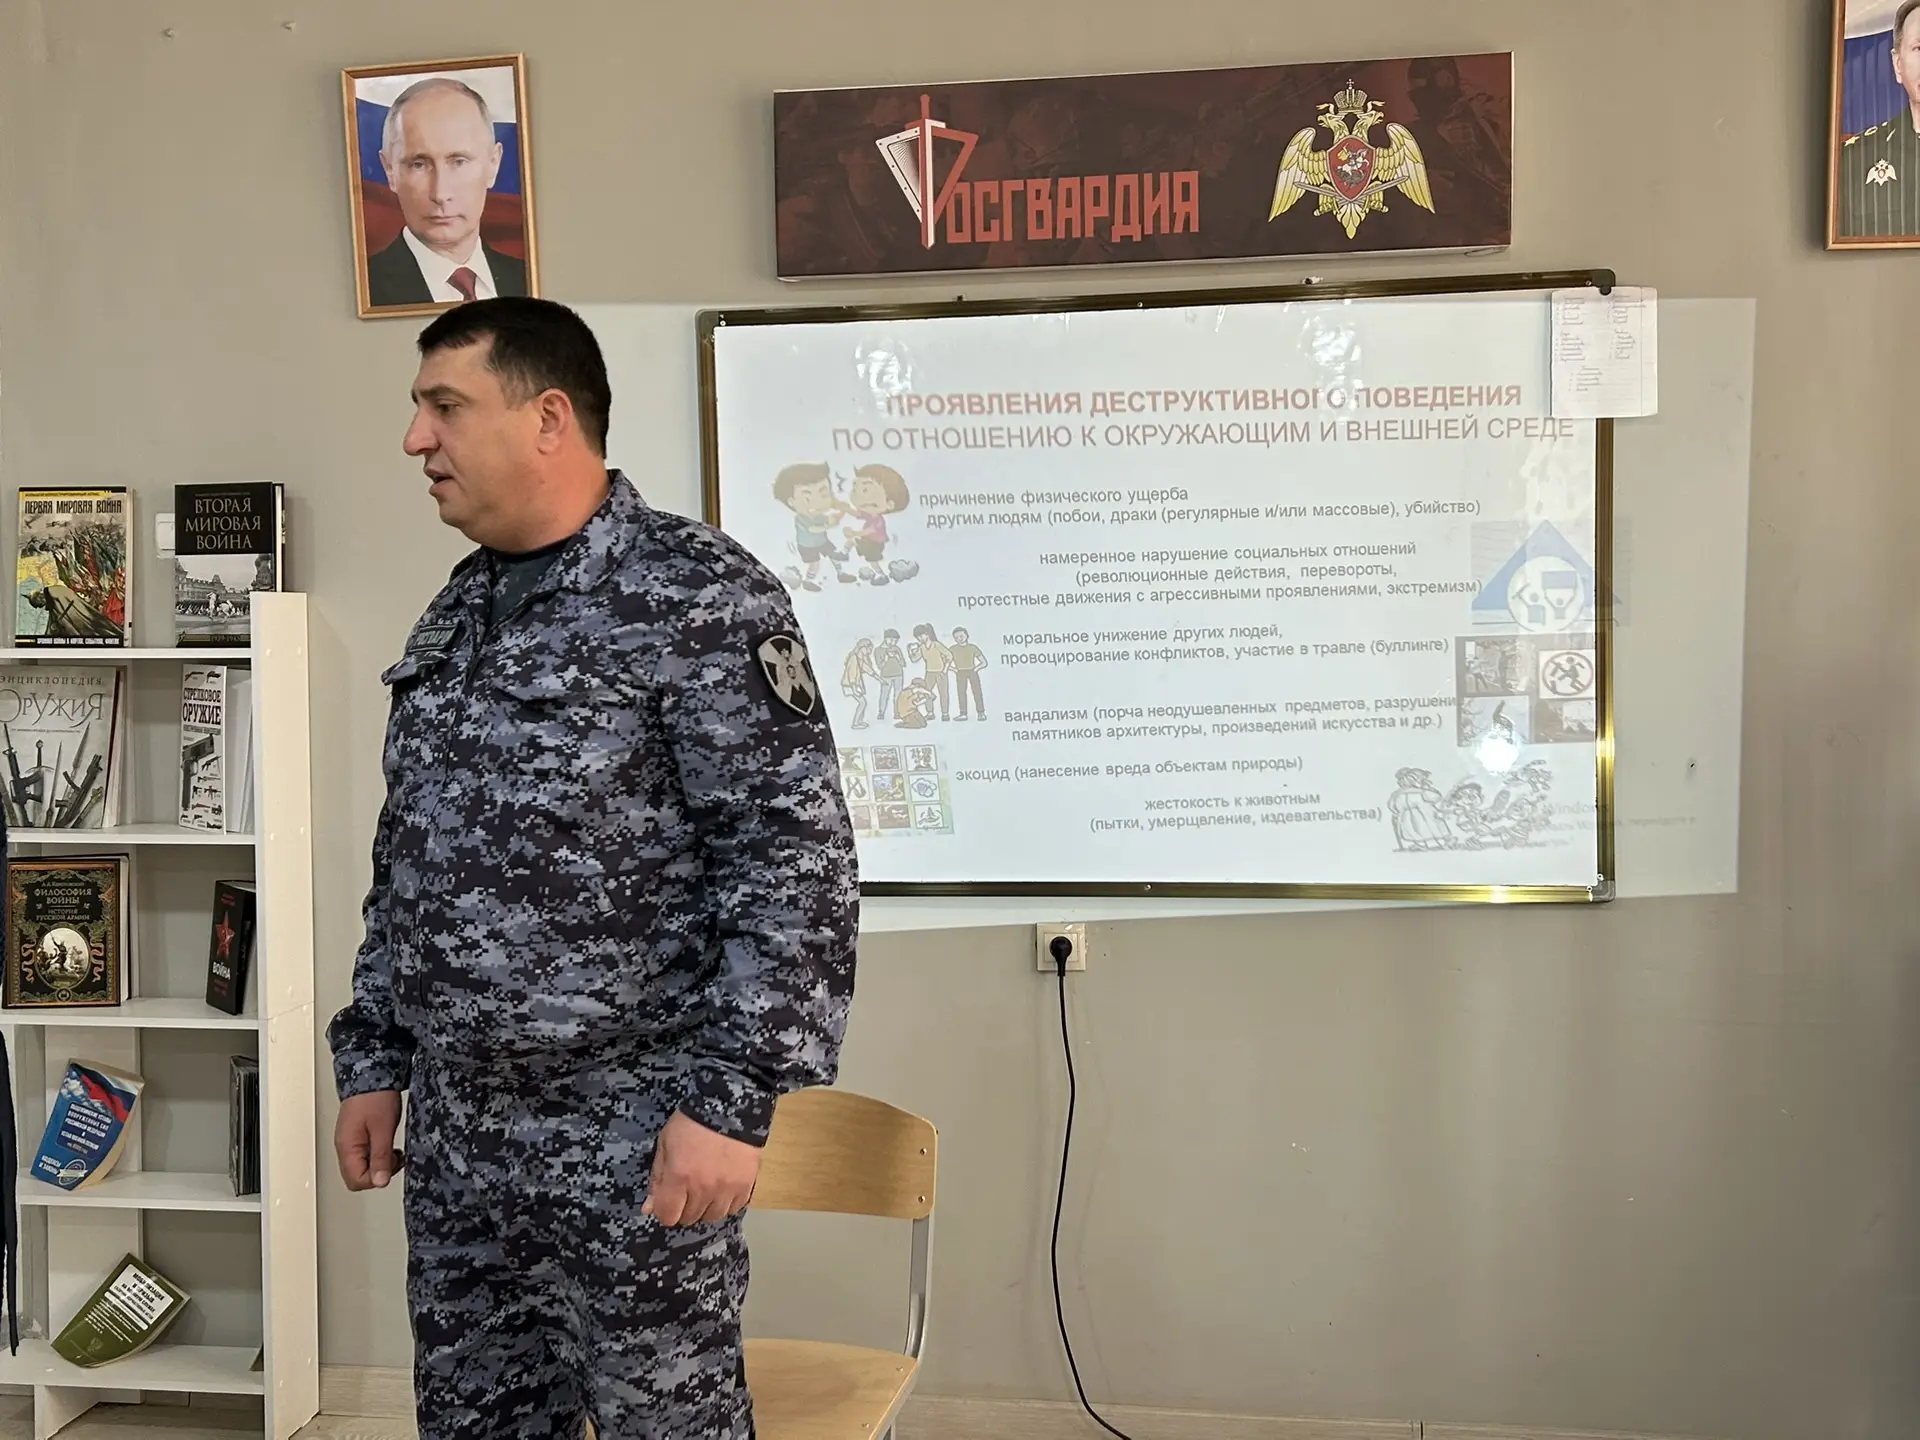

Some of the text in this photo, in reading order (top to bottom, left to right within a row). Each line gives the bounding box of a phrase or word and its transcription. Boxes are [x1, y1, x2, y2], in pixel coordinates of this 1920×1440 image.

[886, 384, 1522, 419] ПРОЯВЛЕНИЯ ДЕСТРУКТИВНОГО ПОВЕДЕНИЯ
[832, 413, 1574, 452] ПО ОТНОШЕНИЮ К ОКРУЖАЮЩИМ И ВНЕШНЕЙ СРЕДЕ
[25, 497, 122, 514] ПЕРВАЯ МИРОВАЯ ВОЙНА
[195, 498, 252, 514] ВТОРАЯ
[919, 485, 1188, 508] причинение физического ущерба
[185, 516, 262, 532] МИРОВАЯ
[926, 498, 1481, 529] другим людям (побои, драки (регулярные и/или массовые), убийство)
[196, 532, 253, 550] ВОЙНА
[1040, 540, 1417, 566] намеренное нарушение социальных отношений
[1075, 562, 1397, 587] (революционные действия, перевороты,
[957, 577, 1482, 610] протестные движения с агрессивными проявлениями, экстремизм)
[1003, 623, 1283, 646] моральное унижение других людей,
[1000, 637, 1449, 667] провоцирование конфликтов, участие в травле (буллинге)
[0, 675, 103, 686] ЭНЦИКЛОПЕДИЯ
[183, 687, 222, 703] СТРЕЛКОВОЕ
[183, 702, 222, 725] ОРУЖИЕ
[1004, 695, 1457, 723] вандализм (порча неодушевленных предметов, разрушени
[1012, 713, 1442, 742] памятников архитектуры, произведений искусства и др.)
[956, 754, 1303, 784] экоцид (нанесение вреда объектам природы)
[1144, 791, 1321, 812] жестокость к животным
[1090, 806, 1383, 833] (пытки, умерщвление, издевательства)
[34, 888, 92, 897] ФИЛОСОФИЯ
[46, 895, 80, 905] ВОЙНЫ
[212, 961, 231, 980] ВОЙНА
